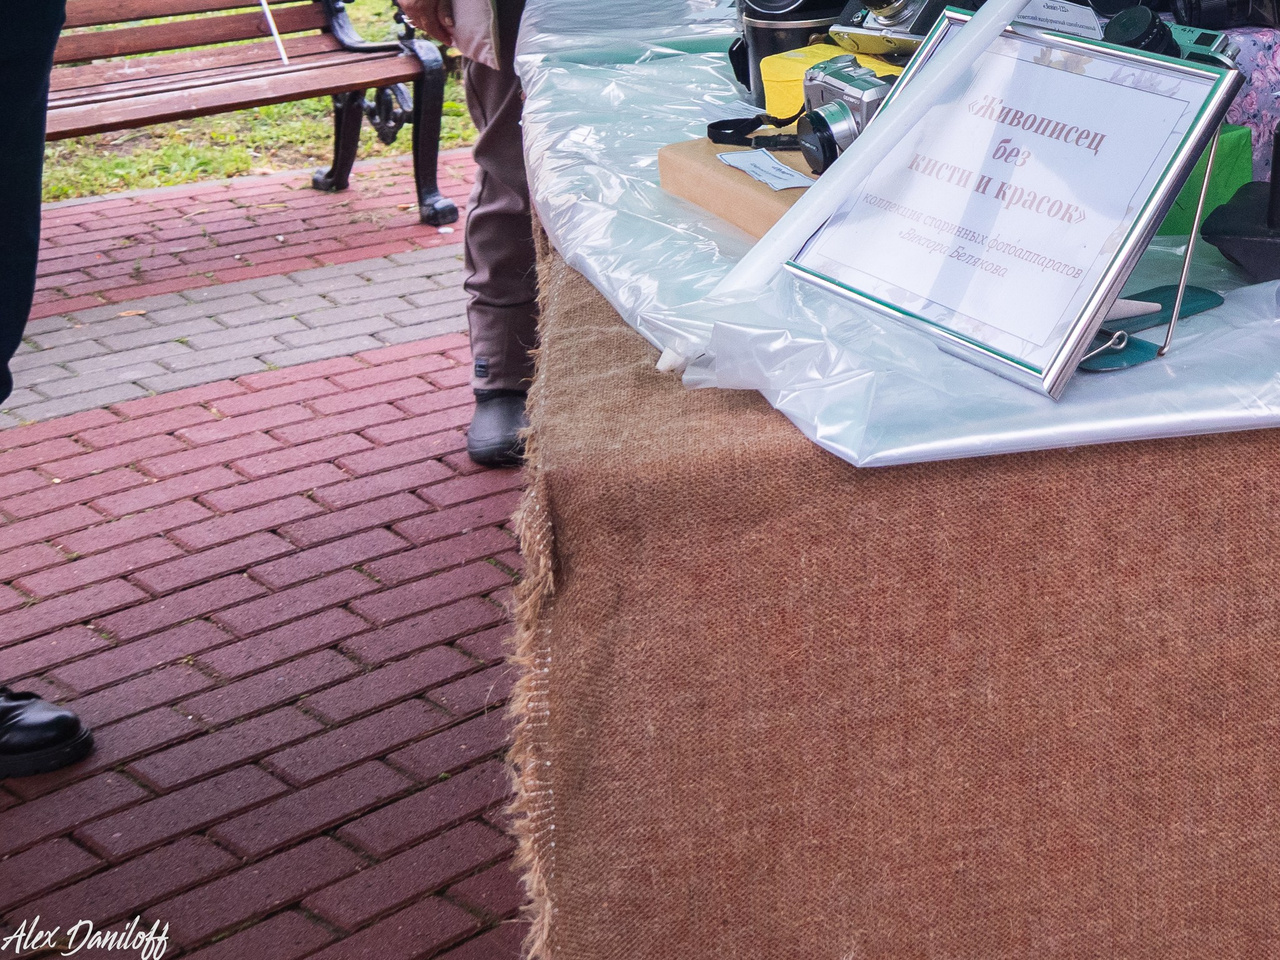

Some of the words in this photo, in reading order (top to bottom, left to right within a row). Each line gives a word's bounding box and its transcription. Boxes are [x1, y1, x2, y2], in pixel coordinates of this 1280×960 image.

[968, 94, 1107, 156] «Живописец
[992, 138, 1032, 167] без
[907, 153, 974, 189] кисти
[974, 174, 993, 195] и
[994, 182, 1087, 224] красок»
[862, 193, 923, 222] коллекция
[923, 214, 988, 246] старинных
[987, 234, 1084, 279] фотоаппаратов
[901, 228, 950, 256] Виктора
[949, 246, 1008, 278] Белякова
